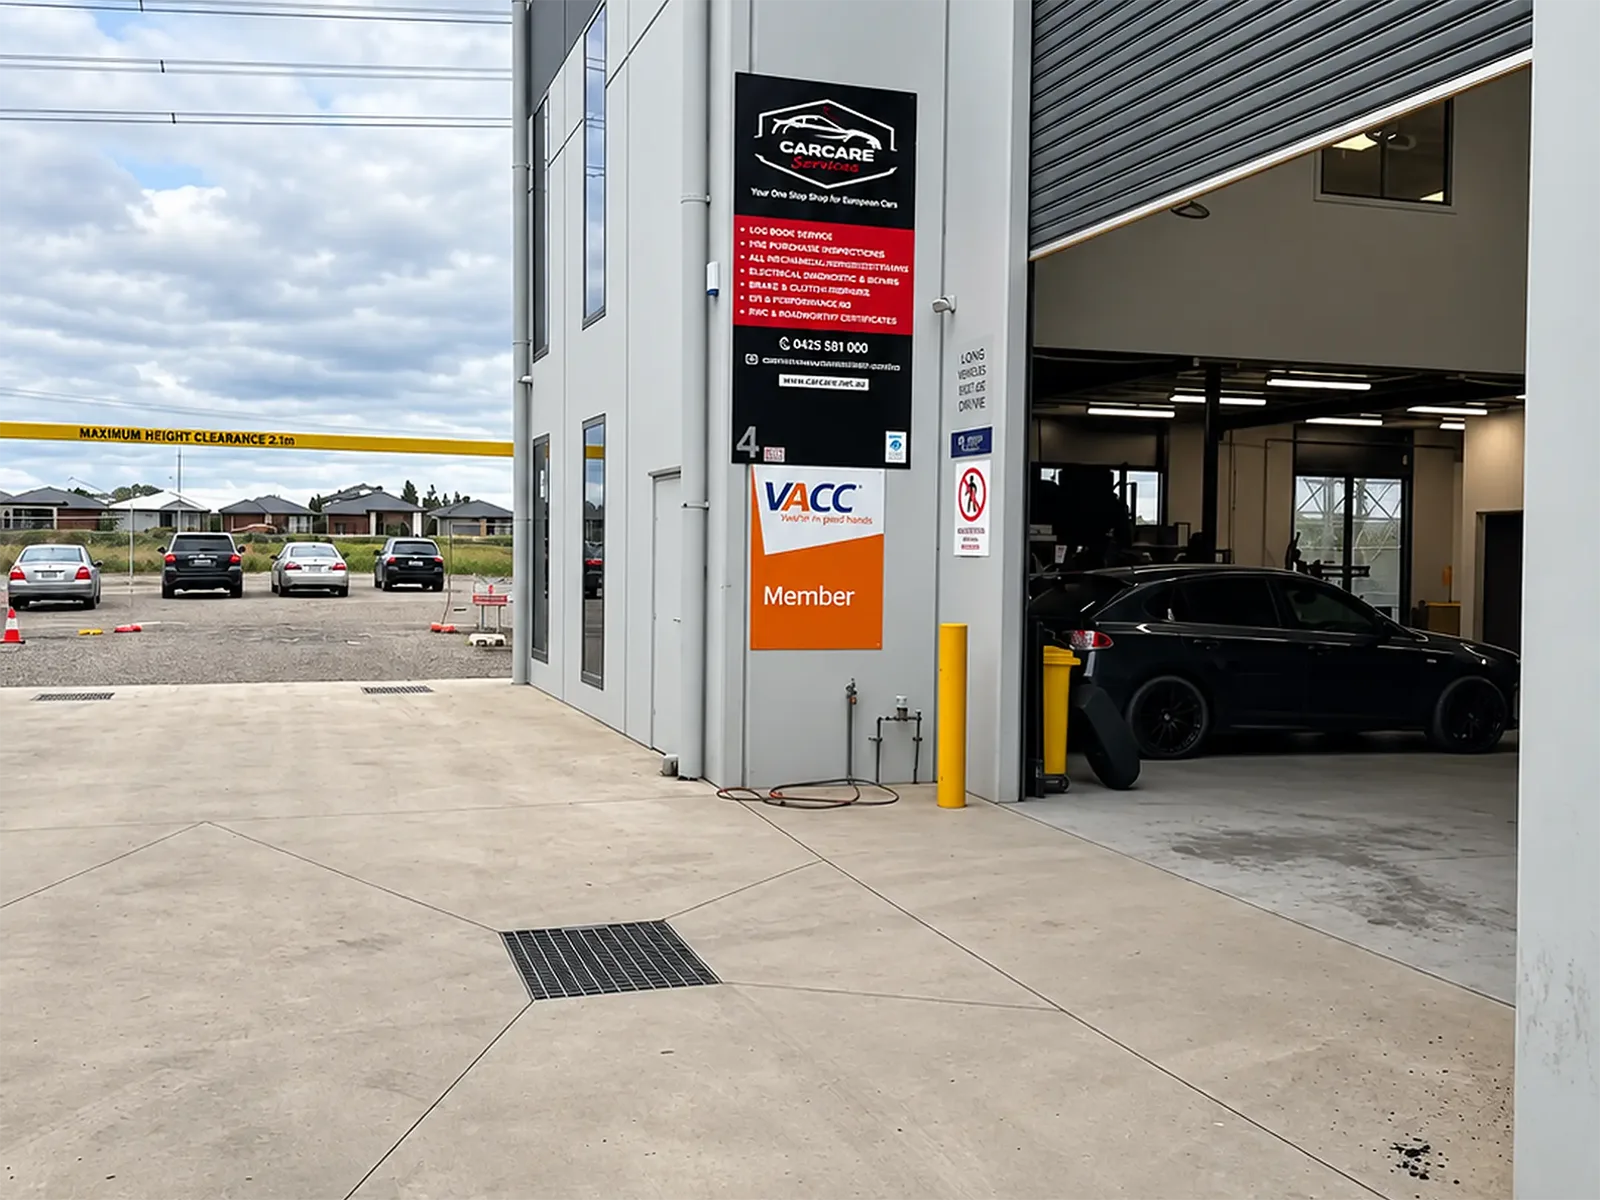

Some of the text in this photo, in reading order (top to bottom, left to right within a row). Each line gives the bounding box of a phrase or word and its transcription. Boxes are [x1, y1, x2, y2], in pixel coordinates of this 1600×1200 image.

[779, 141, 875, 162] CARCARE
[751, 187, 898, 208] Your One Stop Shop for European Cars
[770, 227, 795, 238] BOOK
[793, 338, 868, 354] 0425 581 000
[79, 427, 141, 440] MAXIMUM
[145, 430, 192, 442] HEIGHT
[194, 433, 265, 445] CLEARANCE
[736, 425, 760, 459] 4
[765, 481, 857, 513] VACC
[846, 514, 873, 525] hands
[764, 585, 855, 606] Member
